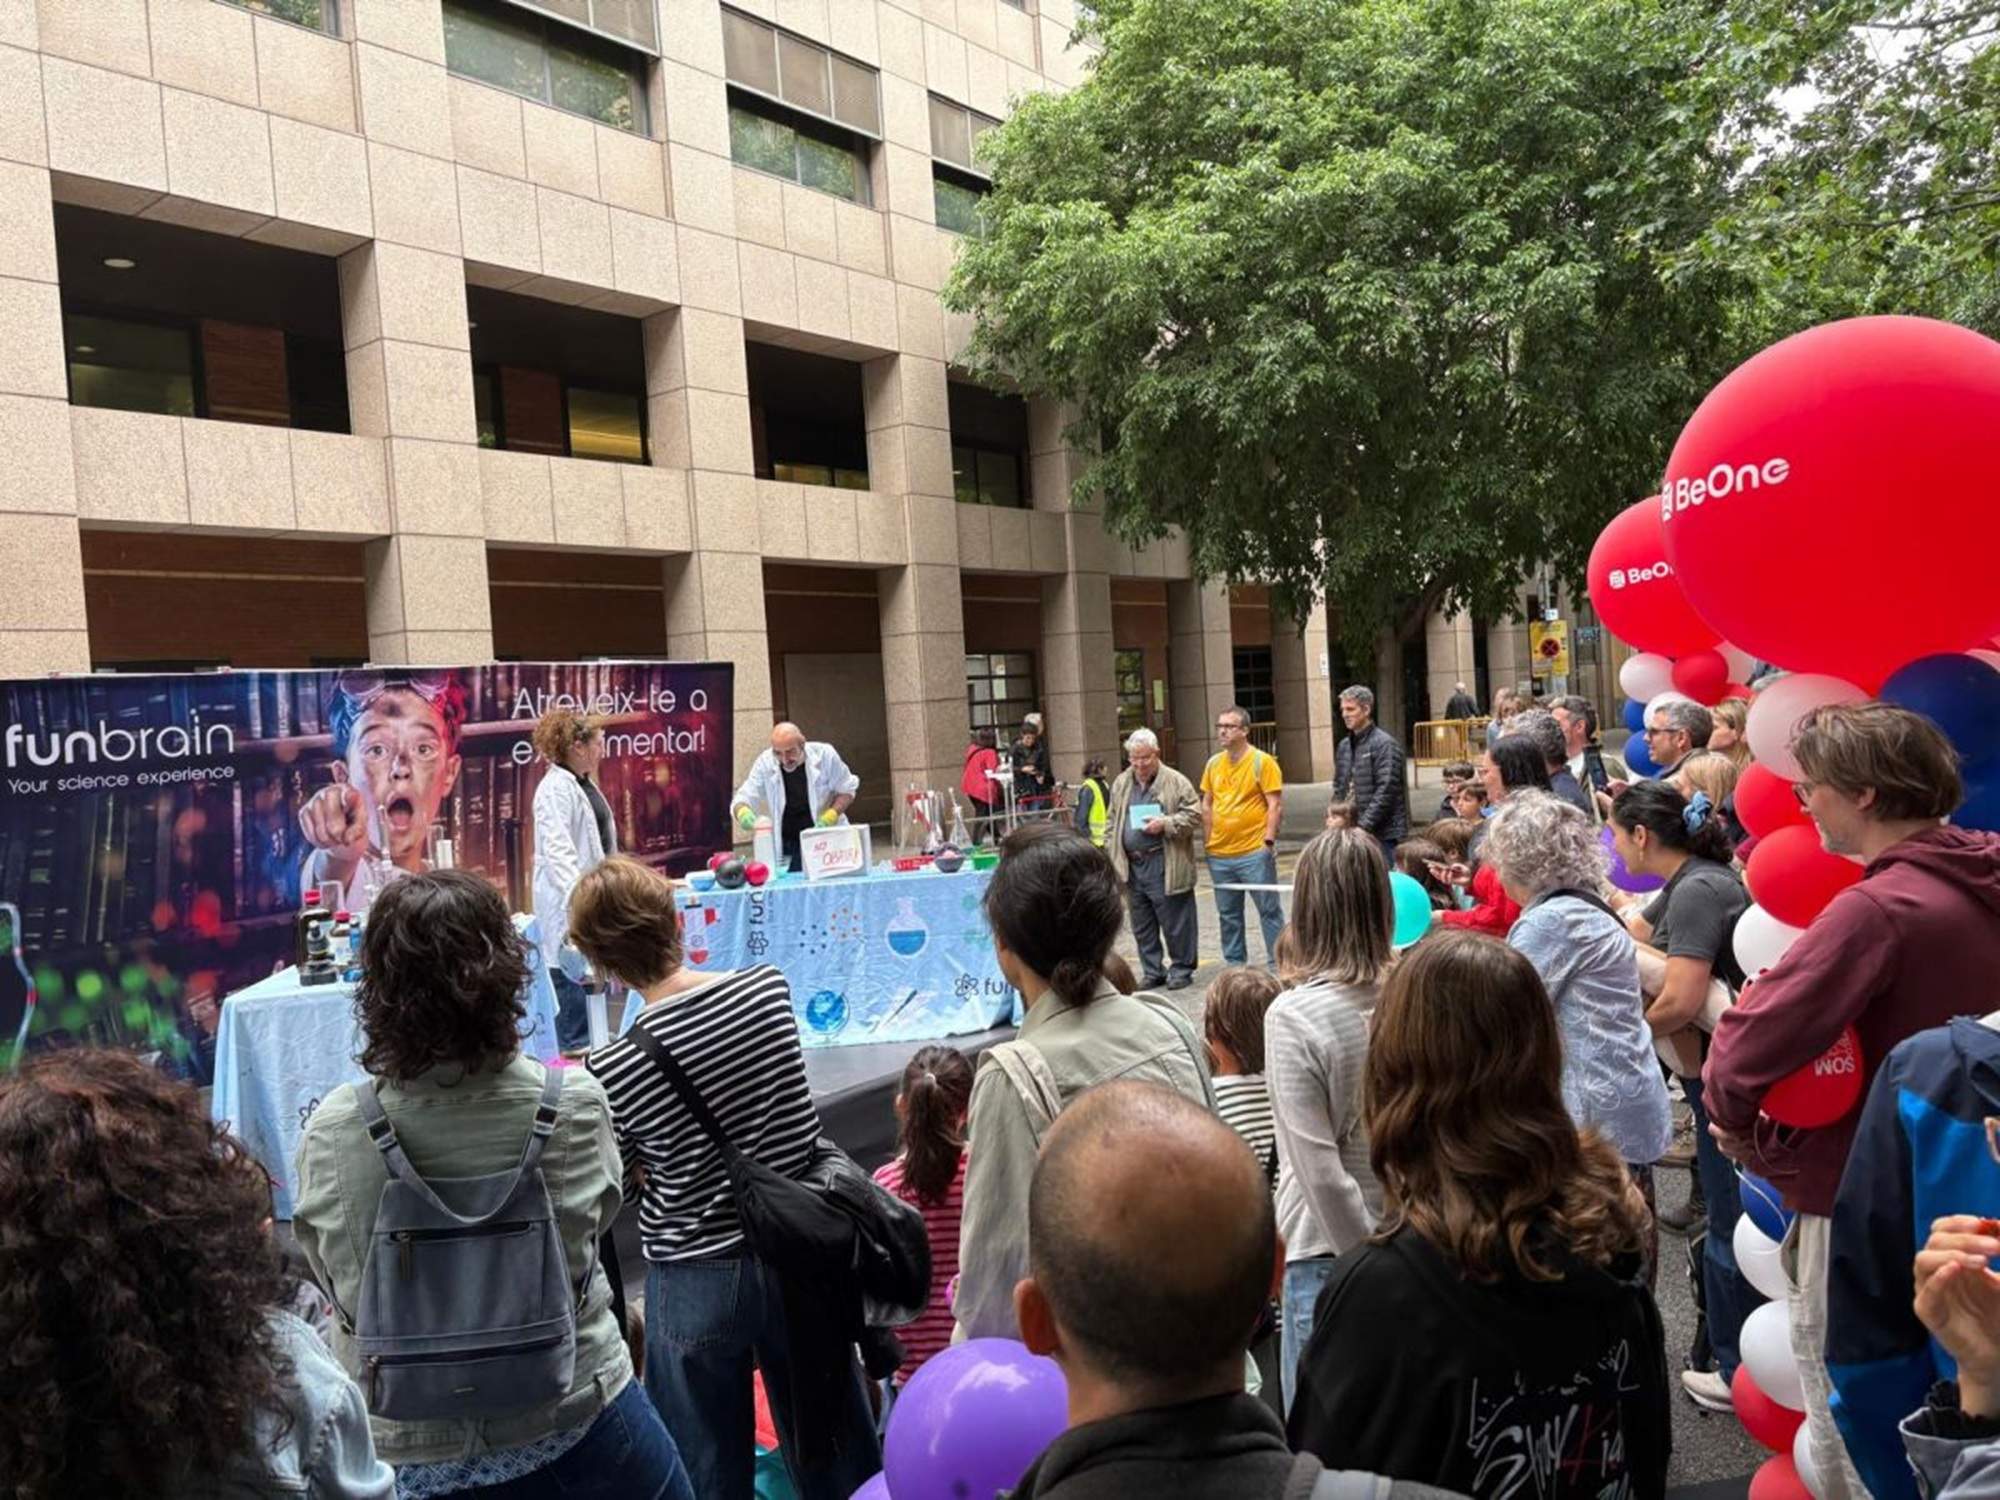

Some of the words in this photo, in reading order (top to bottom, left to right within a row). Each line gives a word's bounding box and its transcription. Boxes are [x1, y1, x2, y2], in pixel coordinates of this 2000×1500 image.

[1675, 457, 1790, 512] BeOne
[511, 684, 677, 719] Atreveix-te
[689, 688, 709, 711] a
[5, 708, 235, 767] funbrain
[8, 778, 49, 795] Your
[58, 773, 130, 792] science
[137, 765, 235, 786] experience
[1814, 1056, 1856, 1077] SOM
